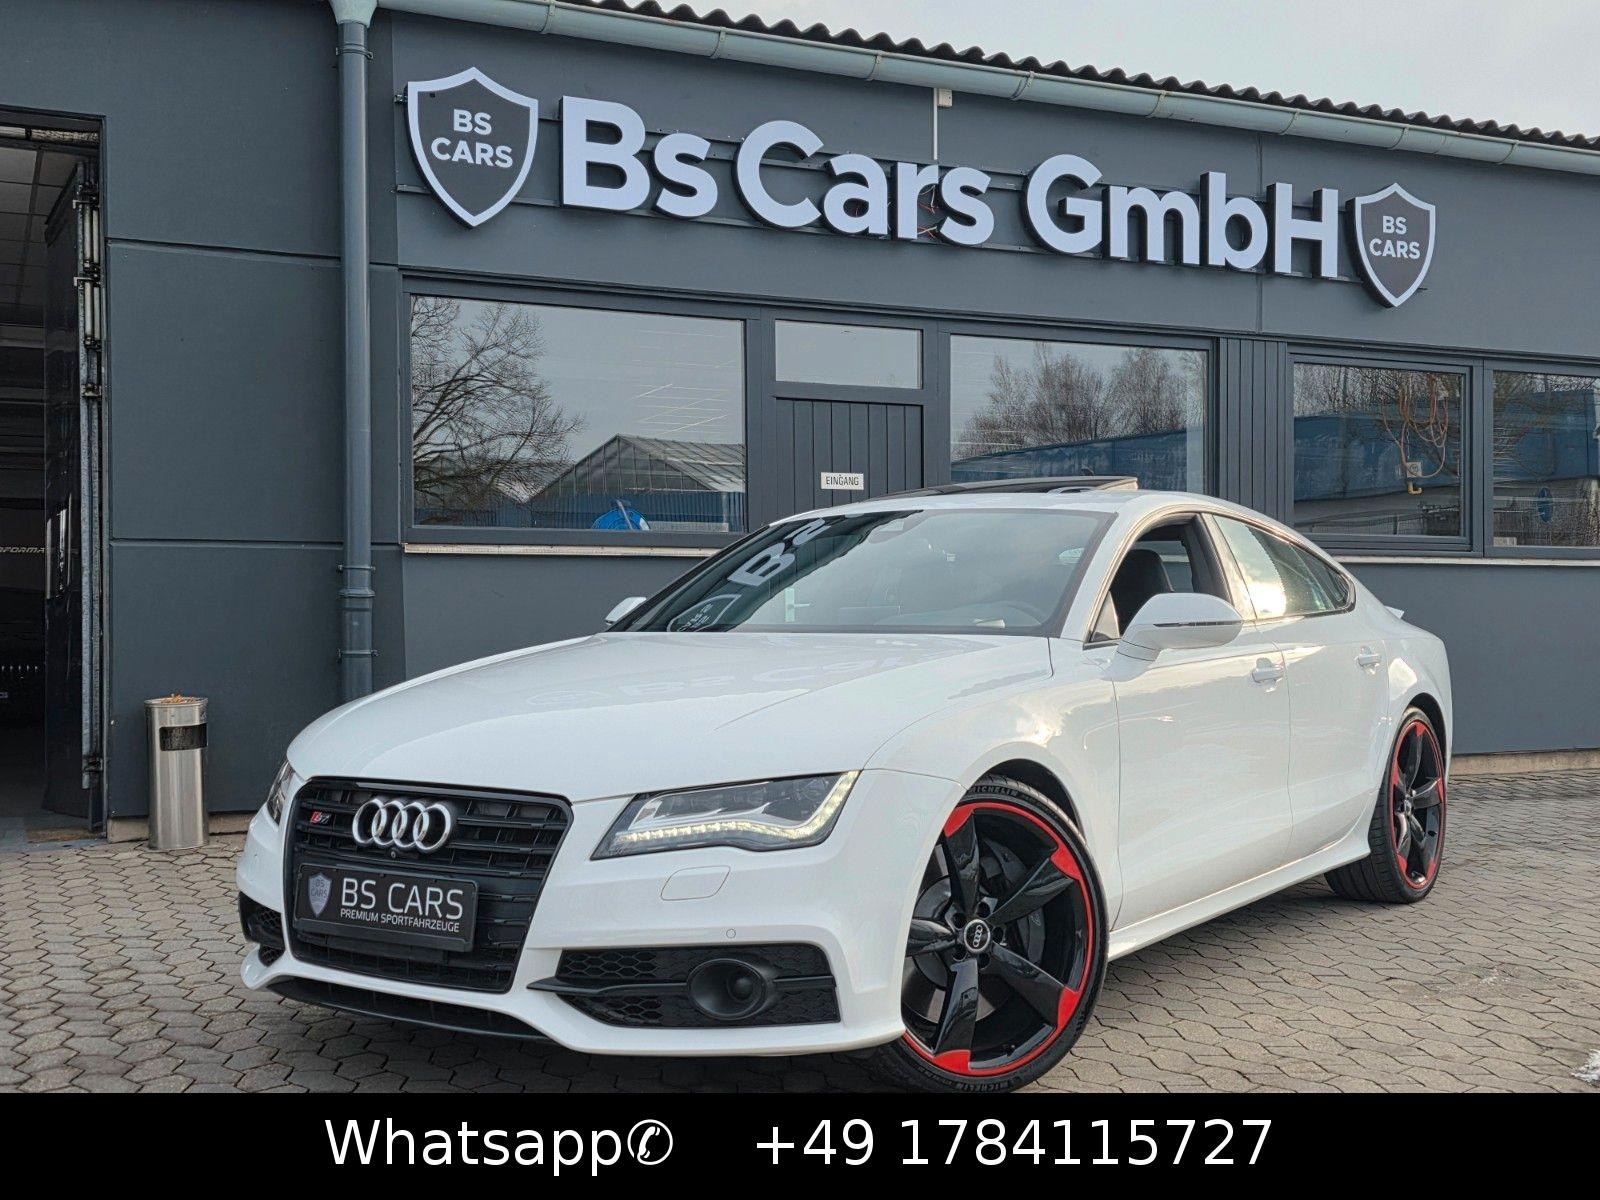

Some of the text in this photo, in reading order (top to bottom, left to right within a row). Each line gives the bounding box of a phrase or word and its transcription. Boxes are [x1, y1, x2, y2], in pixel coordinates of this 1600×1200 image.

[453, 109, 492, 136] BS
[430, 137, 514, 169] CARS
[1027, 154, 1339, 279] GmbH
[1382, 215, 1407, 235] BS
[1369, 238, 1421, 260] CARS
[825, 476, 859, 486] EINGANG
[341, 877, 464, 921] BS CARS
[340, 908, 460, 933] PREMIUM SPORTFAHRZEUGE
